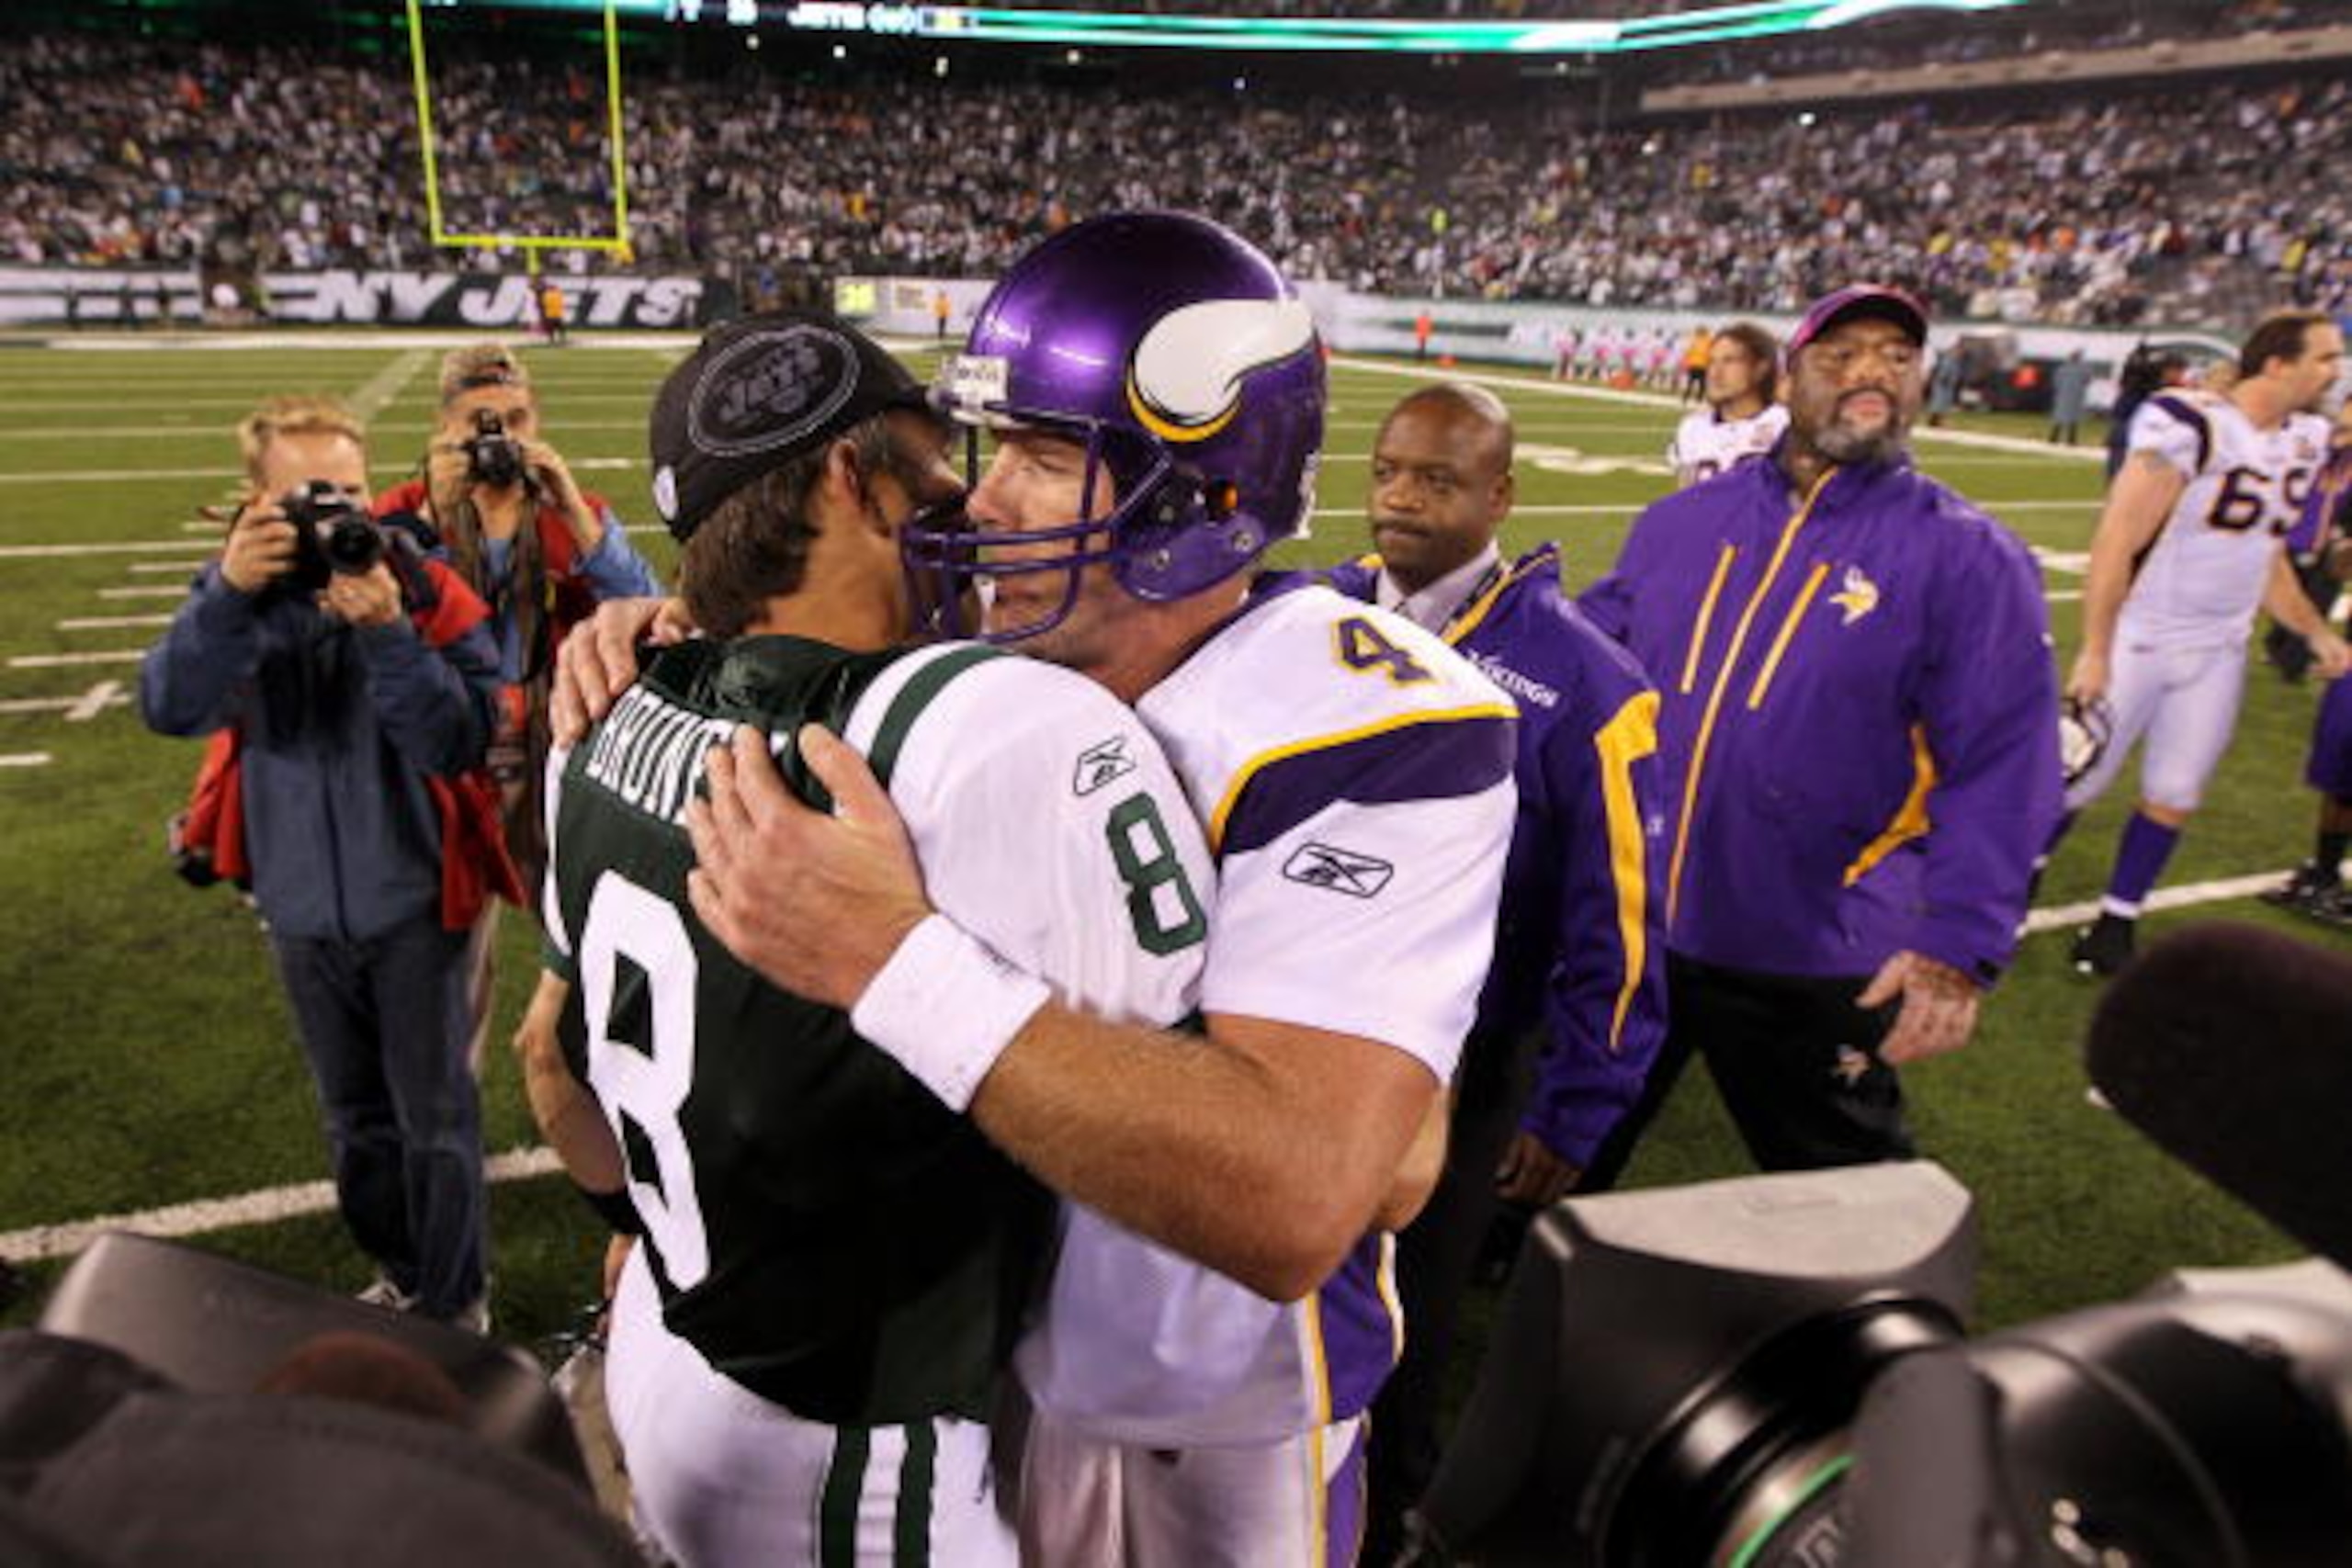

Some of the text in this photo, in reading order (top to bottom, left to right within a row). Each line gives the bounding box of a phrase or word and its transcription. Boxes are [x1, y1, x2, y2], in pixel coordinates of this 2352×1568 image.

[311, 271, 458, 321] NY
[1330, 615, 1440, 688] 4
[1105, 791, 1207, 956] 8
[581, 868, 711, 1292] 8
